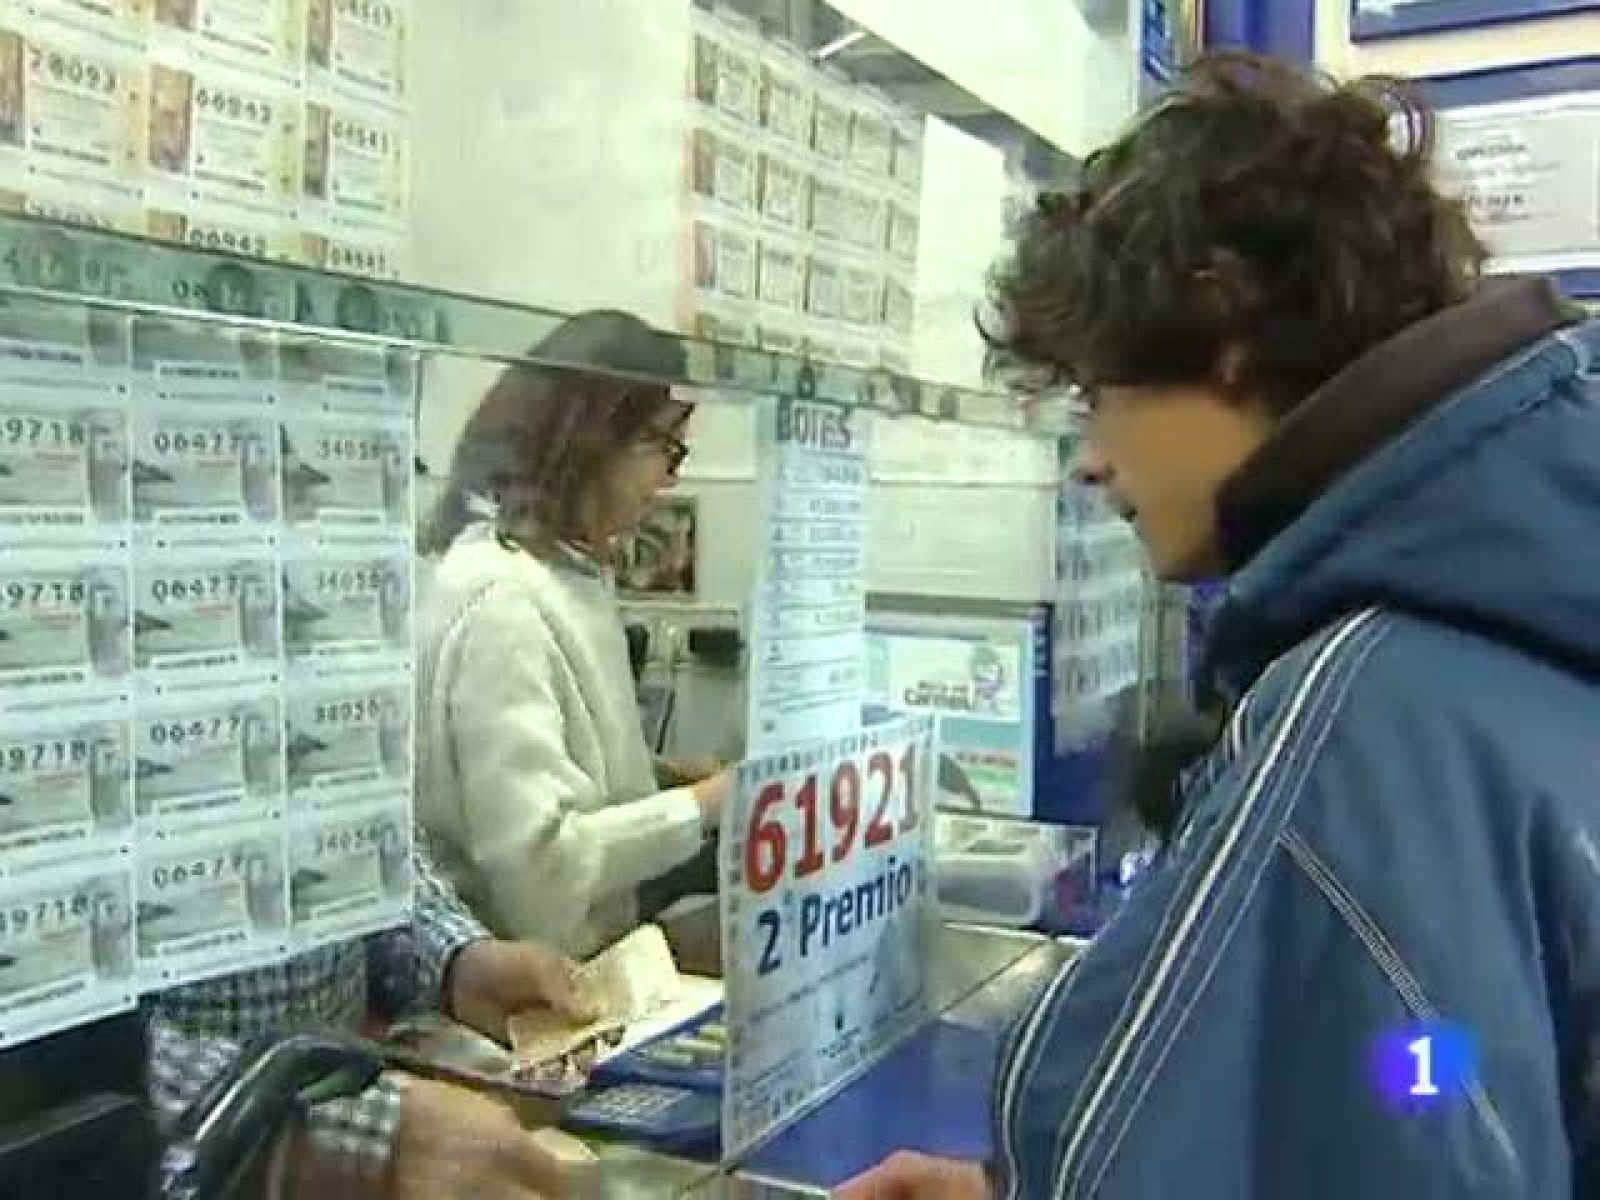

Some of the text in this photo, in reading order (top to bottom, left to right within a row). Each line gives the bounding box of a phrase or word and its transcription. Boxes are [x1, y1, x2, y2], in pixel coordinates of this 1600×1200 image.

[0, 416, 85, 445] 9718
[0, 582, 85, 609] 9718
[745, 743, 918, 894] 61921
[800, 854, 912, 958] Premio
